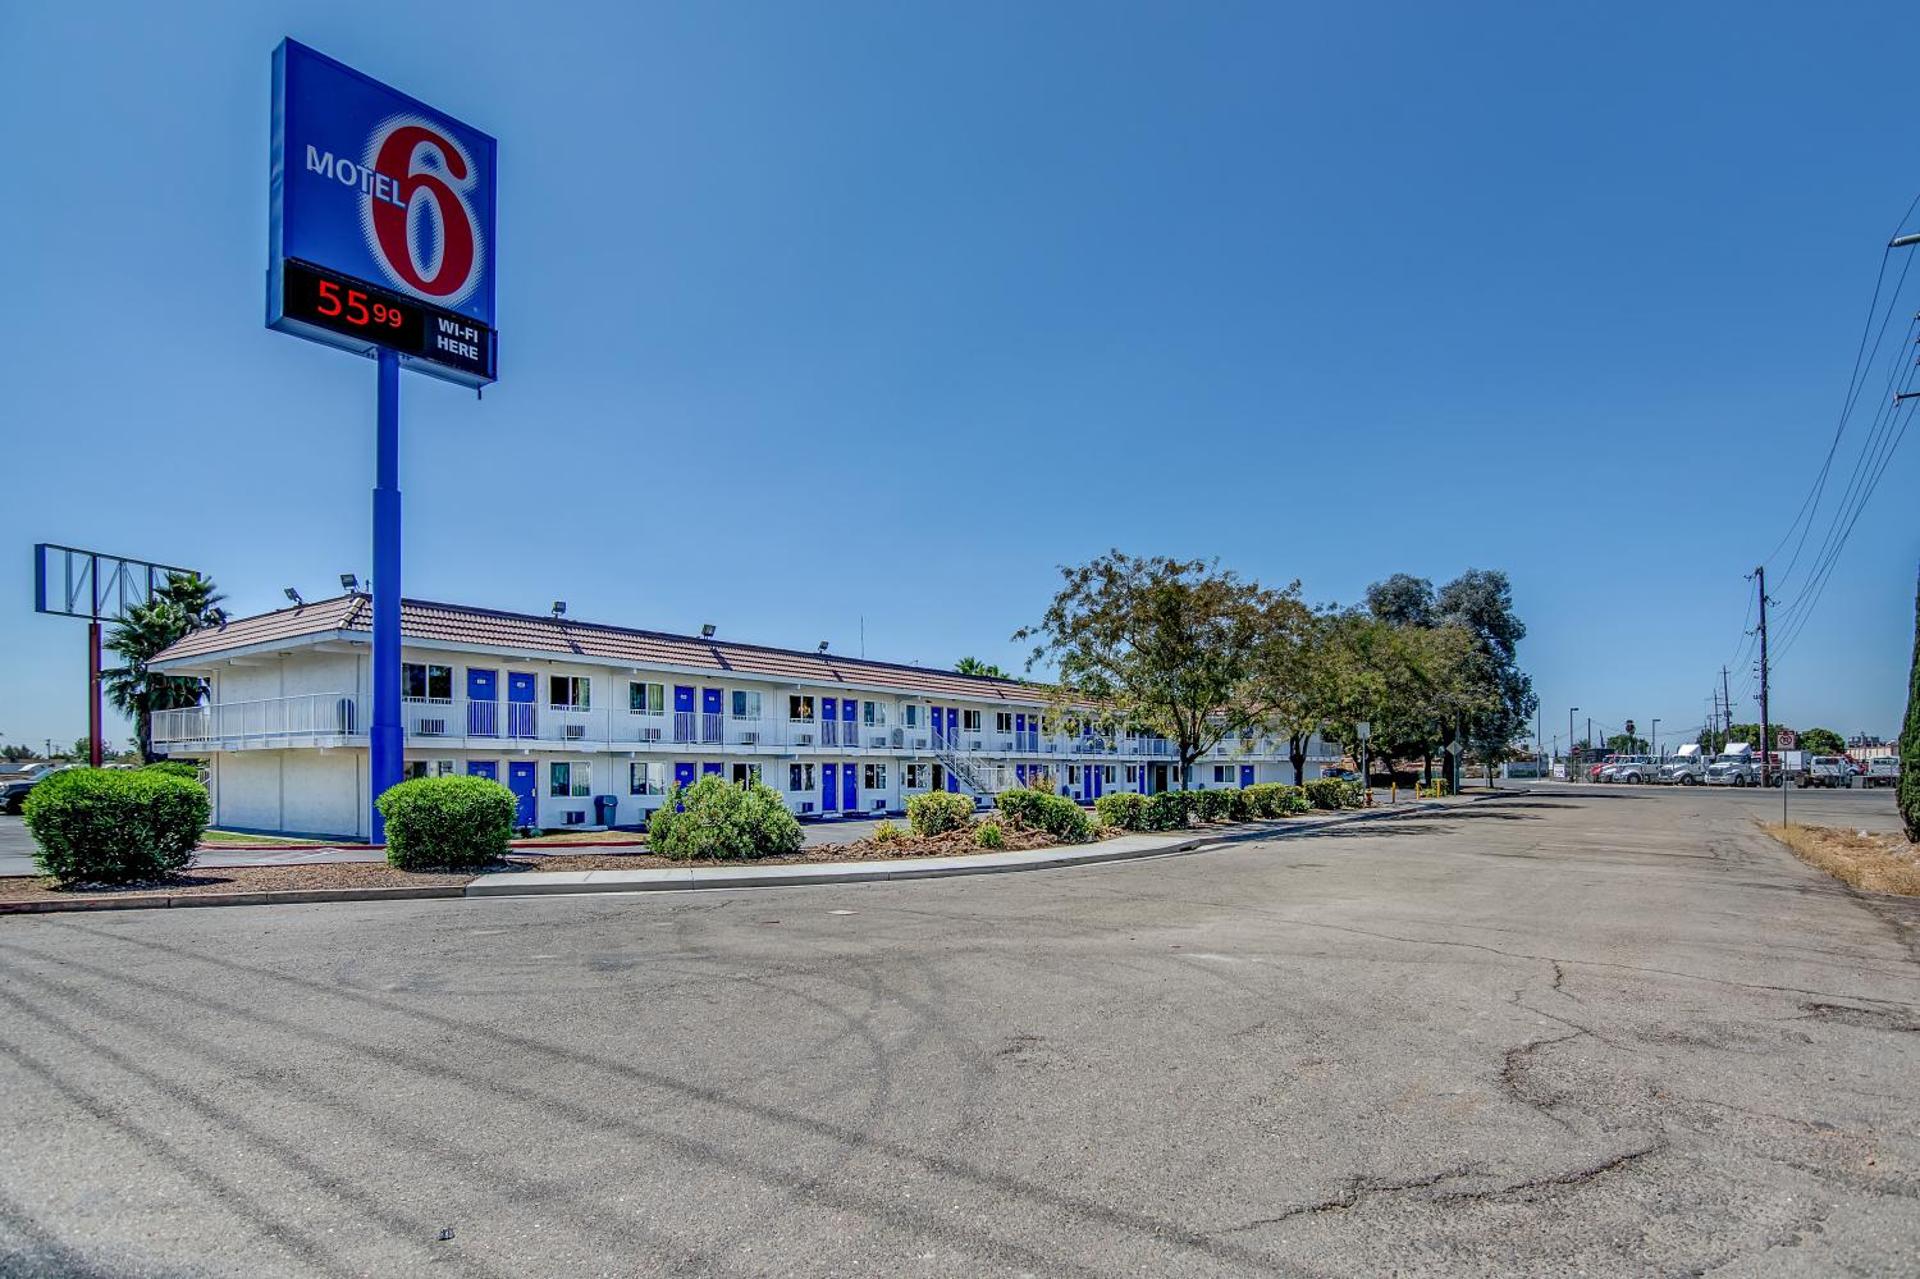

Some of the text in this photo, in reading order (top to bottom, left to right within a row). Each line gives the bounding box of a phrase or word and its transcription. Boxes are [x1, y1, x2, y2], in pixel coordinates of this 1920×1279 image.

[307, 125, 475, 297] MOTEL 6
[438, 317, 478, 343] WI-FI
[437, 335, 479, 361] HERE
